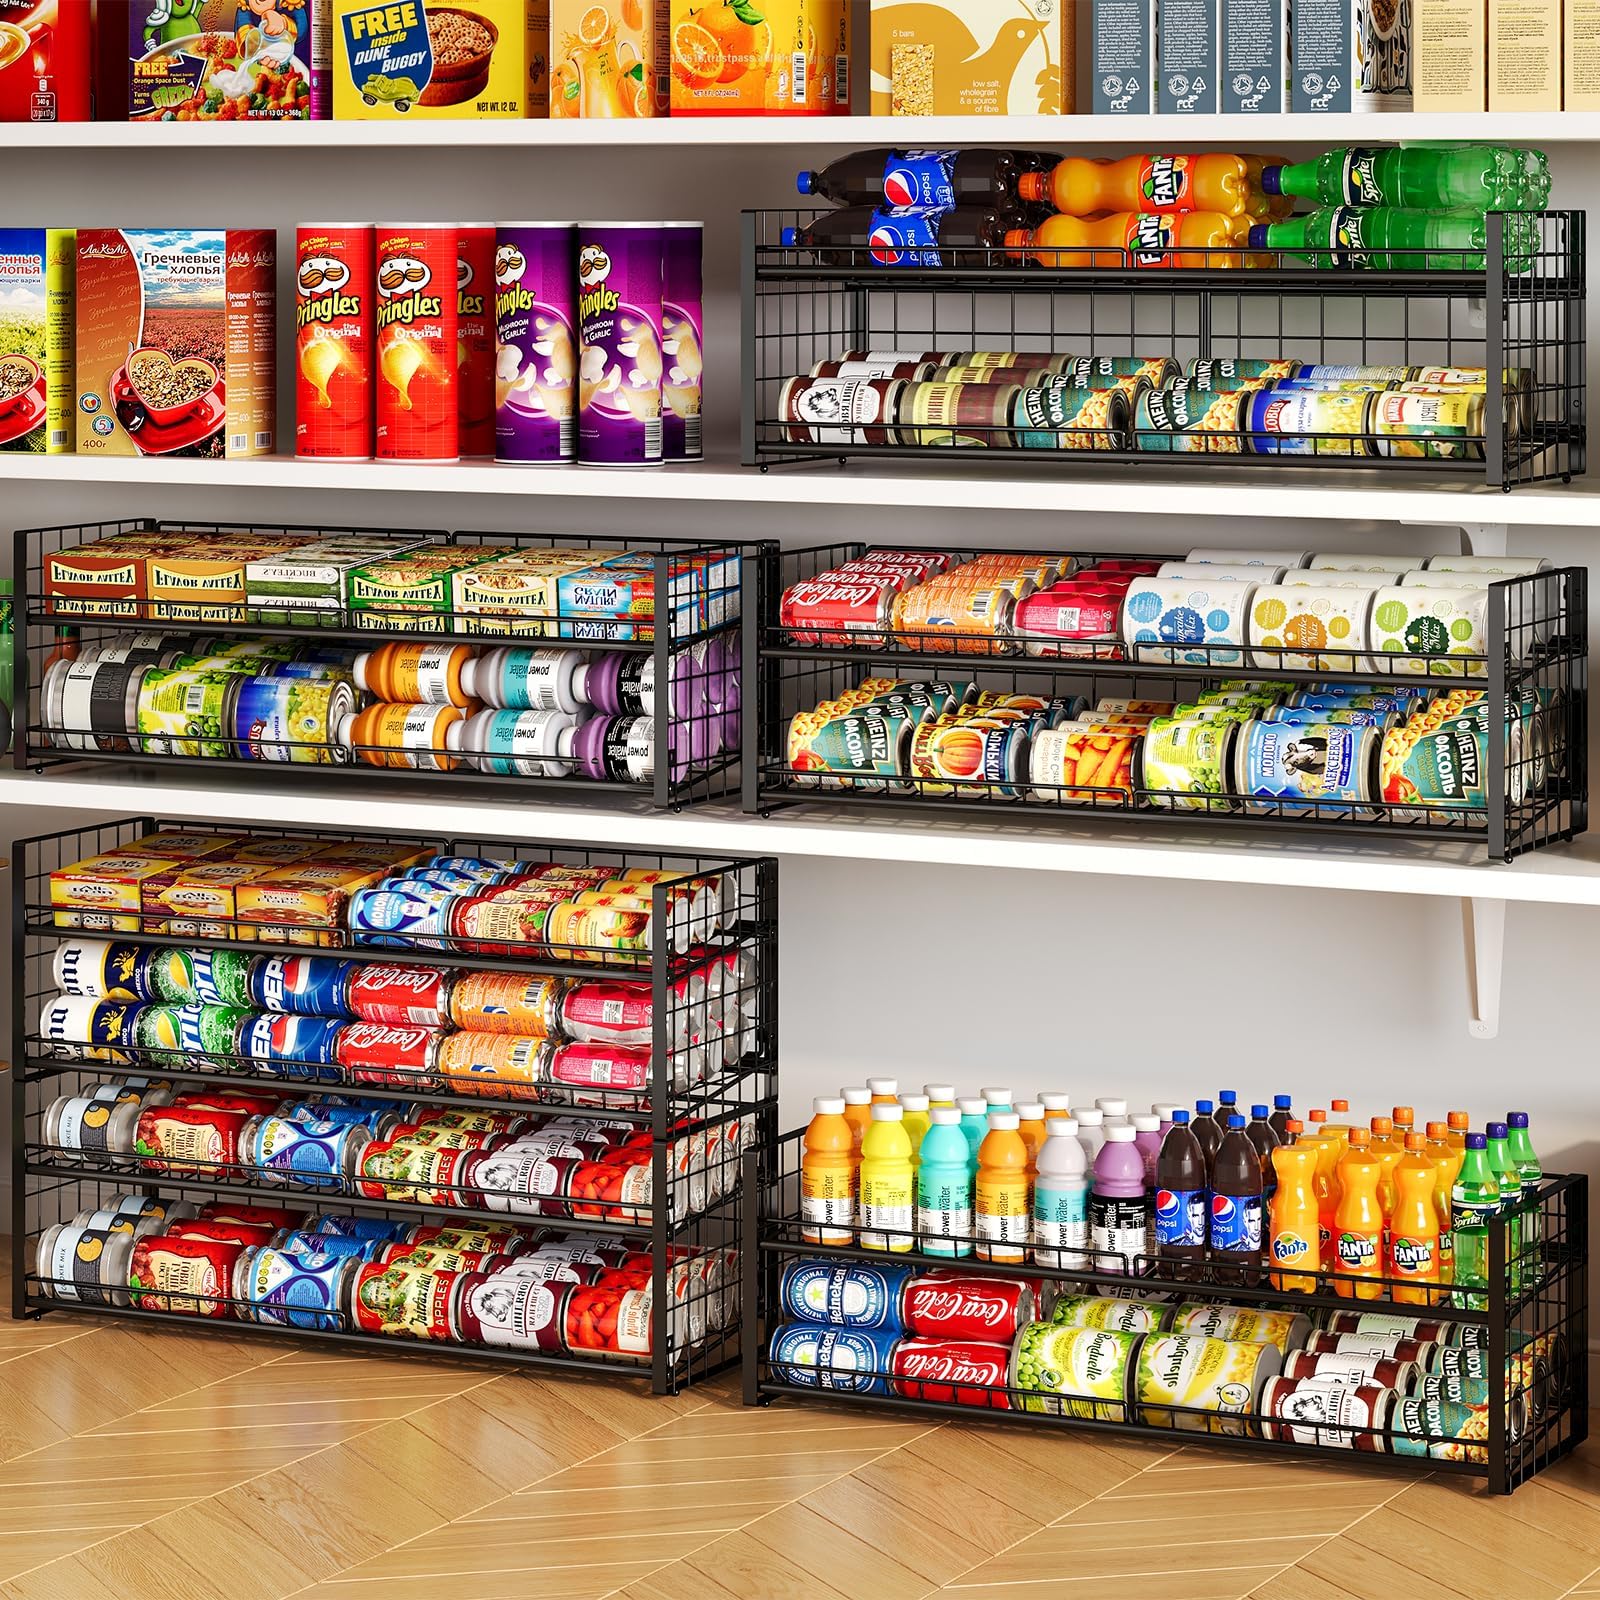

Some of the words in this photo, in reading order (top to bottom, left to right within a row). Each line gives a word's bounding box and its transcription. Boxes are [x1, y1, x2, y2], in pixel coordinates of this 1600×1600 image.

[350, 3, 418, 40] FREE
[370, 30, 406, 49] inside
[892, 29, 898, 37] 5
[354, 45, 391, 66] DUNE
[381, 50, 427, 73] BUGGY
[134, 62, 169, 76] FREE
[959, 88, 997, 98] wholegrain
[972, 79, 985, 88] low
[151, 85, 195, 109] GREEN
[476, 102, 489, 112] NET
[501, 102, 508, 111] 12
[959, 97, 965, 105] &
[974, 105, 982, 113] of
[982, 105, 999, 113] fibre
[921, 172, 932, 205] pepsi
[1152, 156, 1175, 207] FANTA
[1359, 158, 1380, 204] Sprite
[144, 252, 221, 266] Гречневые
[157, 277, 197, 285] требующие
[170, 266, 221, 275] хлопья
[314, 325, 361, 339] Original
[394, 326, 443, 340] Original
[505, 327, 527, 341] GARLIC
[583, 319, 615, 335] MUSHROOM
[589, 328, 612, 342] GARLIC
[1024, 389, 1043, 428] HEINZ
[1150, 390, 1165, 430] HEINZ
[1264, 399, 1291, 435] LOBUS
[1173, 610, 1187, 643] upcake
[1185, 614, 1197, 640] Mix
[1298, 616, 1311, 650] upcake
[1307, 621, 1319, 646] Mix
[1421, 619, 1431, 653] upcake
[1430, 624, 1441, 653] Mix
[843, 718, 863, 768] ФАСОЛЬ
[868, 717, 888, 760] HEINZ
[1262, 733, 1278, 778] МОЛОКО
[1436, 735, 1457, 796] ФАСОЛЬ
[1457, 735, 1477, 785] HEINZ
[371, 892, 391, 929] МОЛОКО
[1157, 1219, 1178, 1232] pepsi
[1213, 1224, 1234, 1237] pepsi
[1453, 1215, 1482, 1231] Sprite
[1273, 1239, 1309, 1260] Fanta
[1338, 1240, 1375, 1257] FANTA
[1393, 1245, 1432, 1262] FANTA
[415, 1274, 433, 1293] Hall
[434, 1279, 449, 1327] APPLES
[829, 1267, 847, 1325] Heineken
[910, 1290, 1009, 1328] Coca-Cola
[1085, 1332, 1113, 1382] Bonduelle
